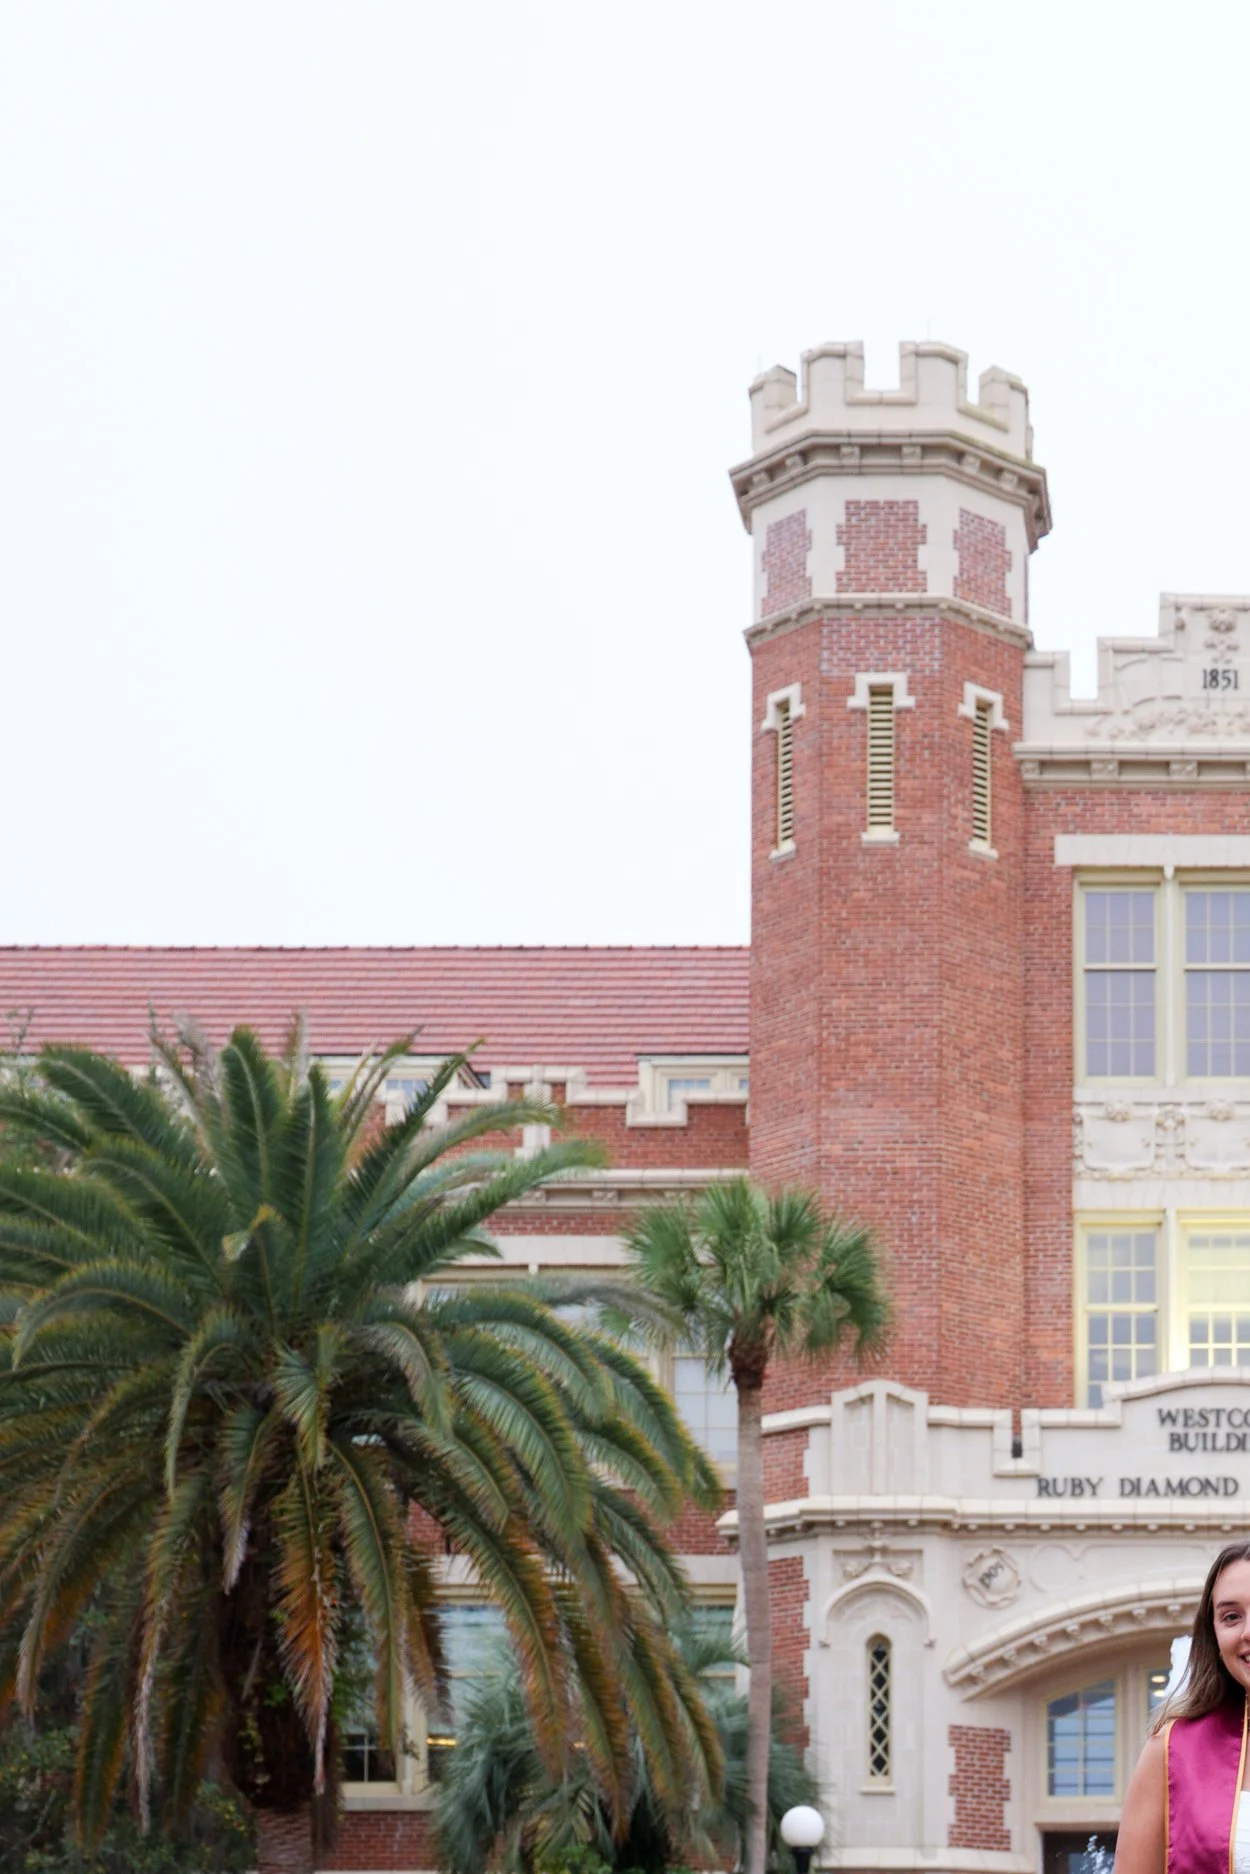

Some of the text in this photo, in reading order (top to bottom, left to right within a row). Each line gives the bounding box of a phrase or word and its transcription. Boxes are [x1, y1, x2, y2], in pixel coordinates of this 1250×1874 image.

[1202, 668, 1239, 690] 1851
[1036, 1477, 1103, 1498] RUBY
[1119, 1477, 1239, 1498] DIAMOND
